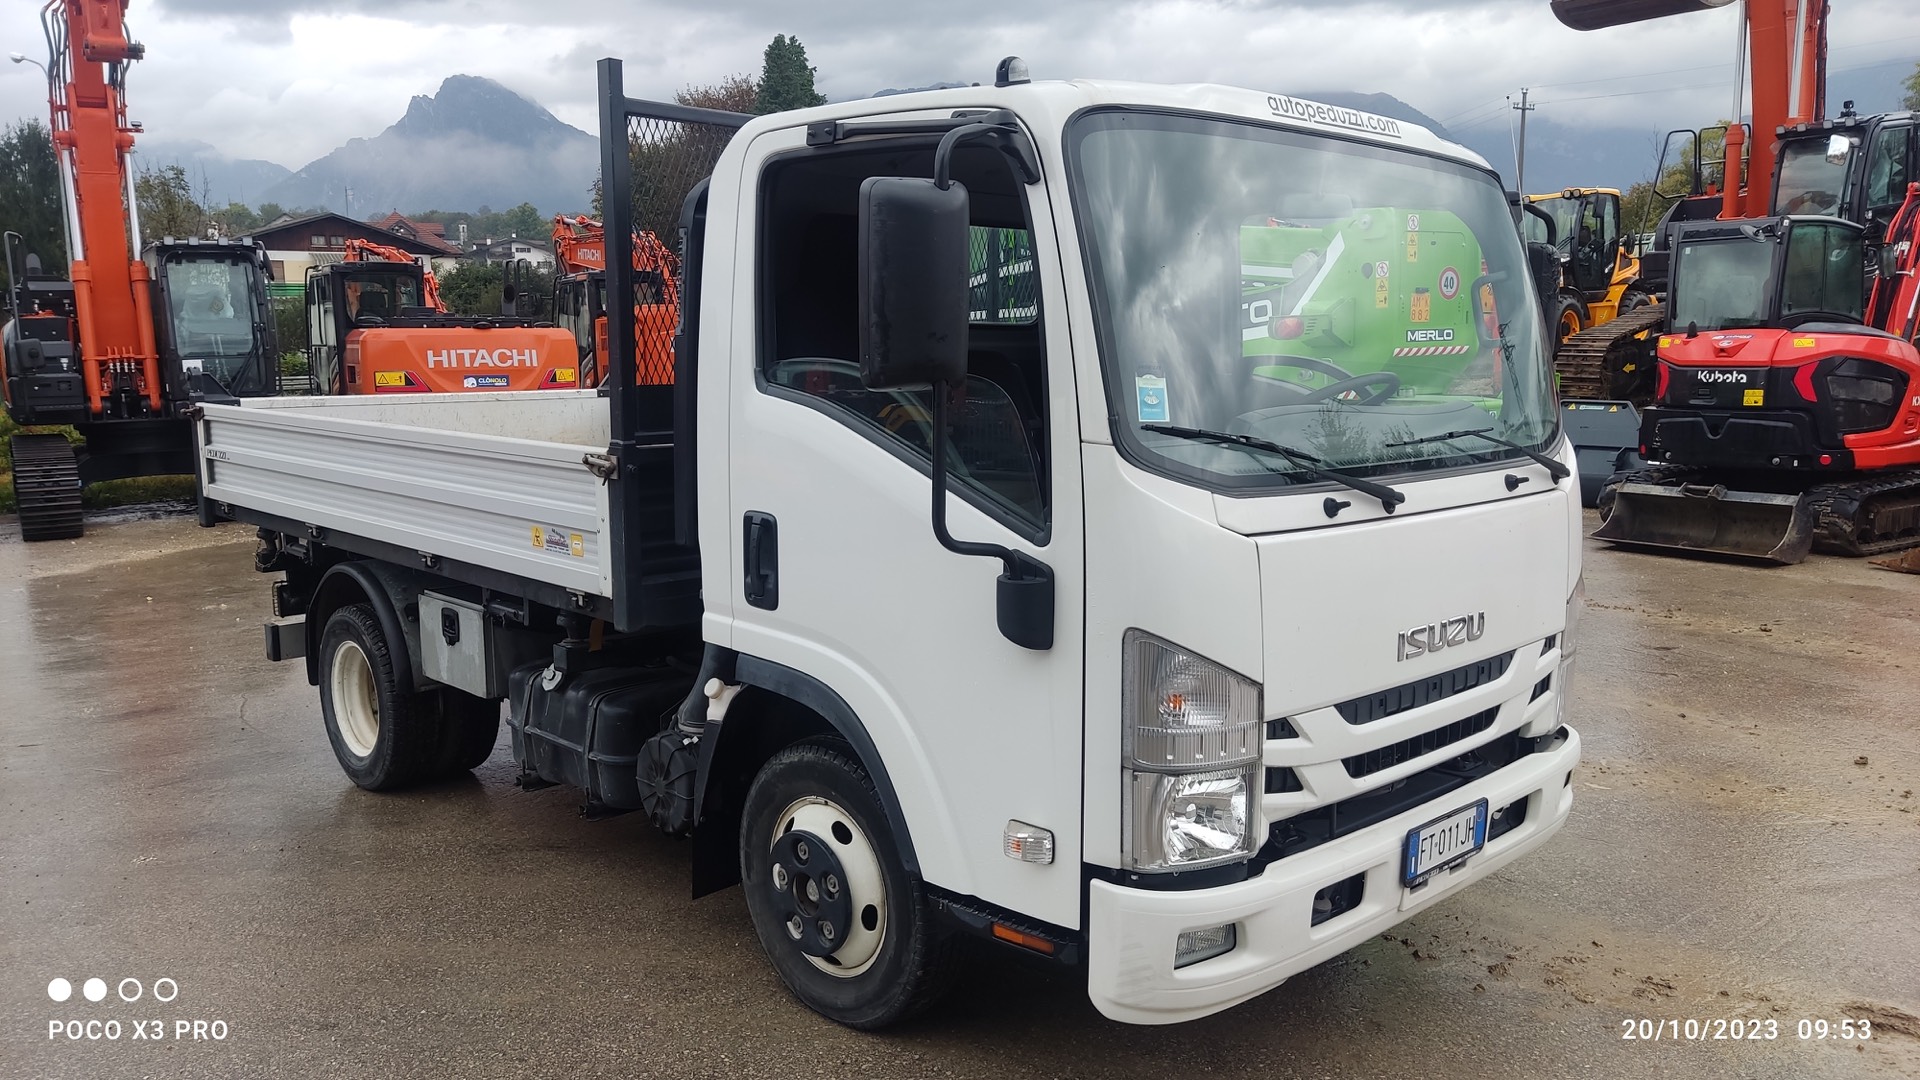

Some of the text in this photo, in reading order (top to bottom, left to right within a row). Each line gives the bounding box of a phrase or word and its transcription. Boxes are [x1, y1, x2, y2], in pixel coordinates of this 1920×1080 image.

[1267, 95, 1400, 135] autopeduzzi.com
[577, 247, 602, 261] HITACHI
[1443, 276, 1455, 290] 40
[1407, 329, 1453, 341] MERLO
[427, 348, 538, 369] HITACHI
[1697, 370, 1747, 383] Kubota
[1397, 610, 1484, 662] ISUZU
